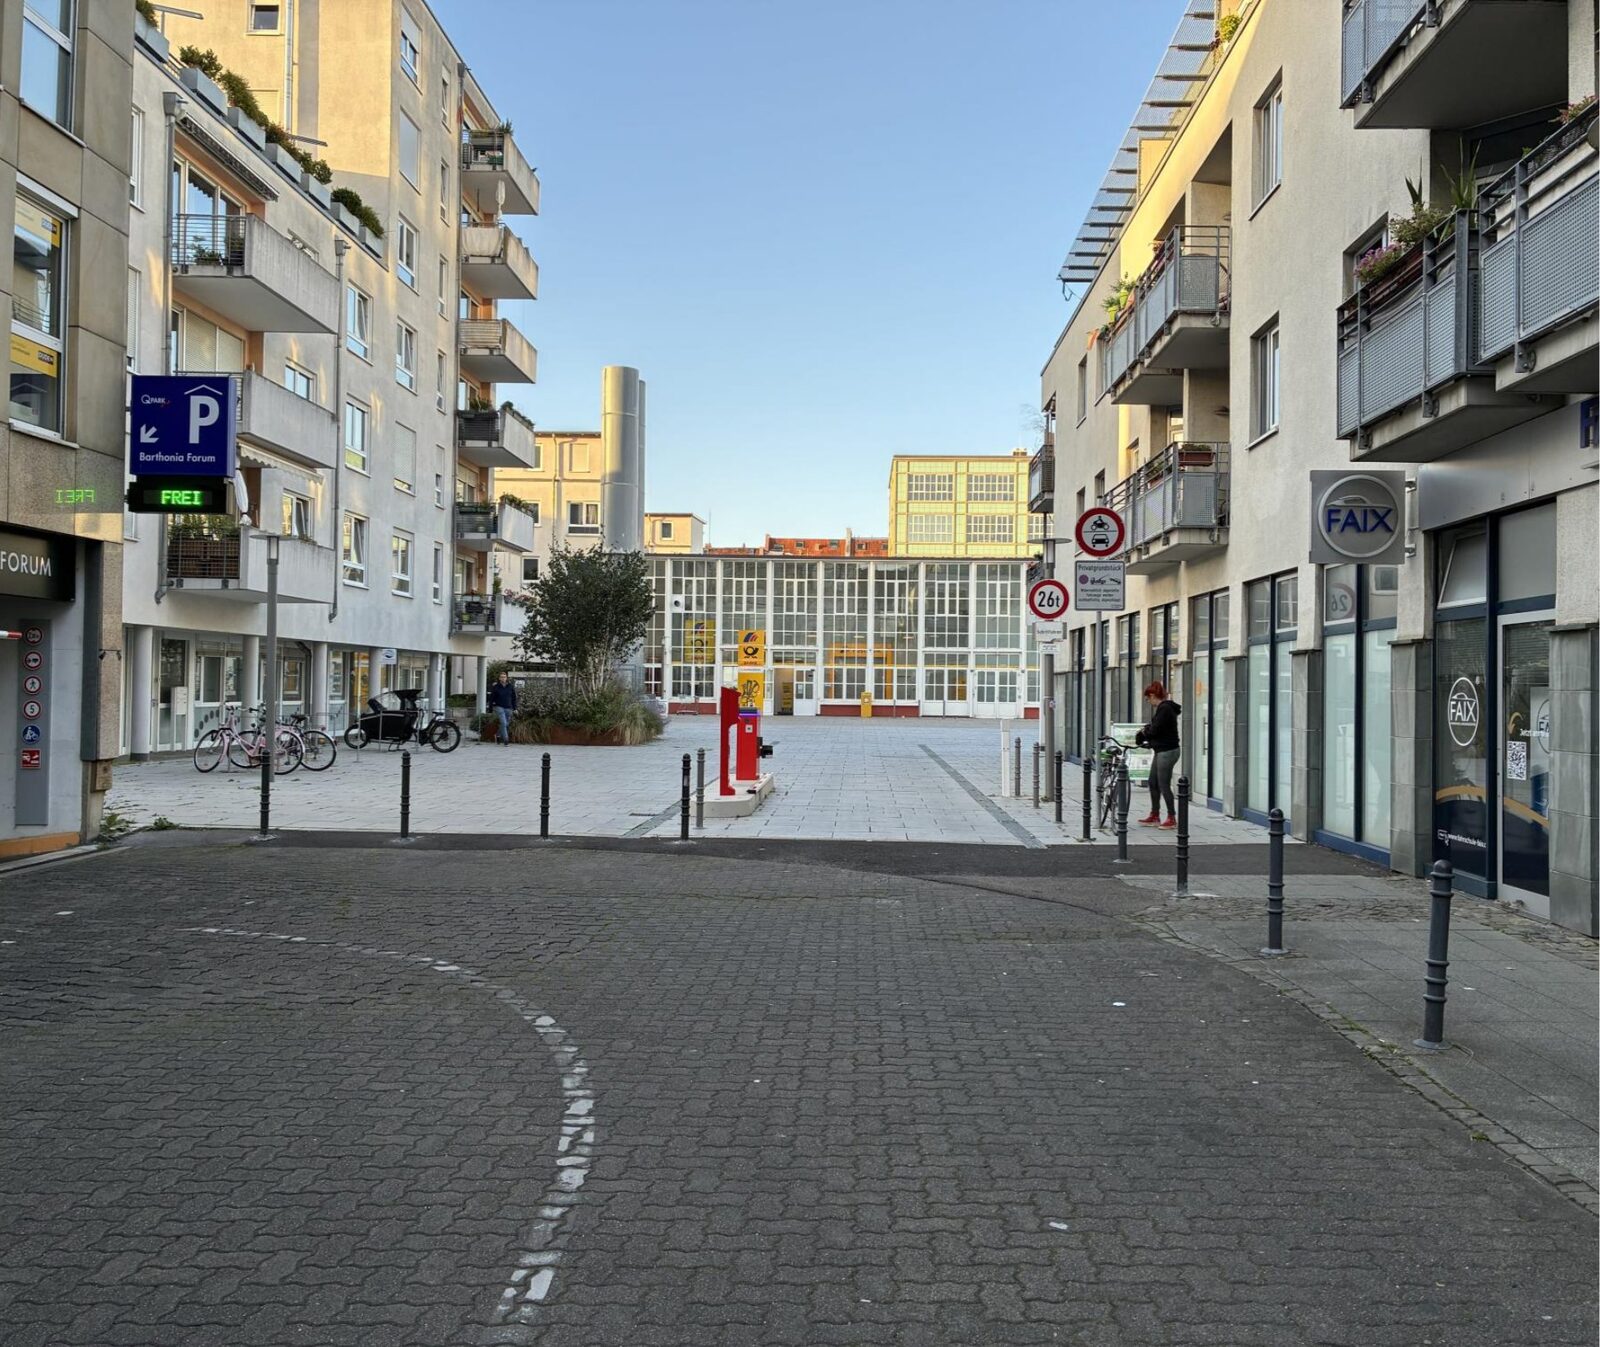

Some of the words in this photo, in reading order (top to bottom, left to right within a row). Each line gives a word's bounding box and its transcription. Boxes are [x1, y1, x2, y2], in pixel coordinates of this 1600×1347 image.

[189, 395, 219, 444] P
[139, 451, 184, 462] Barthonia
[186, 453, 216, 463] Forum
[160, 489, 202, 505] FREI
[1327, 508, 1394, 533] FAIX
[0, 550, 52, 577] FORUM
[30, 704, 35, 714] 5
[1450, 701, 1477, 722] FAIX
